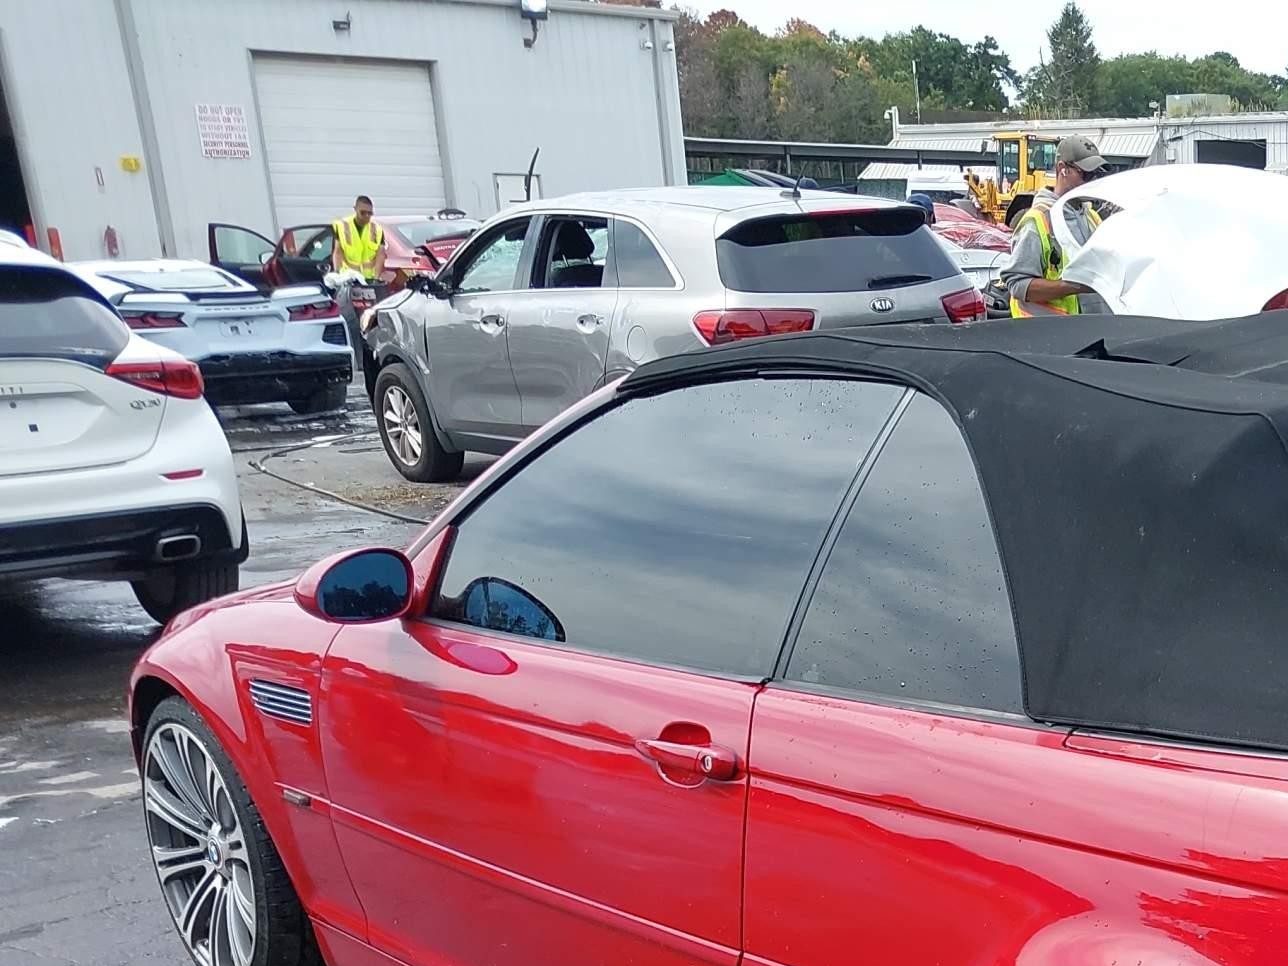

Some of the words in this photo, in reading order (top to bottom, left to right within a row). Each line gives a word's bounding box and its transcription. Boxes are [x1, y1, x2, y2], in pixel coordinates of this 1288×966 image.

[198, 105, 208, 114] DO
[210, 105, 223, 115] NOT
[225, 106, 242, 116] OPEN
[201, 132, 233, 140] WITHOUT
[203, 140, 223, 148] SECURITY
[224, 140, 248, 149] PERSONNEL
[204, 148, 250, 157] AUTHORIZATION
[874, 300, 892, 310] KIA
